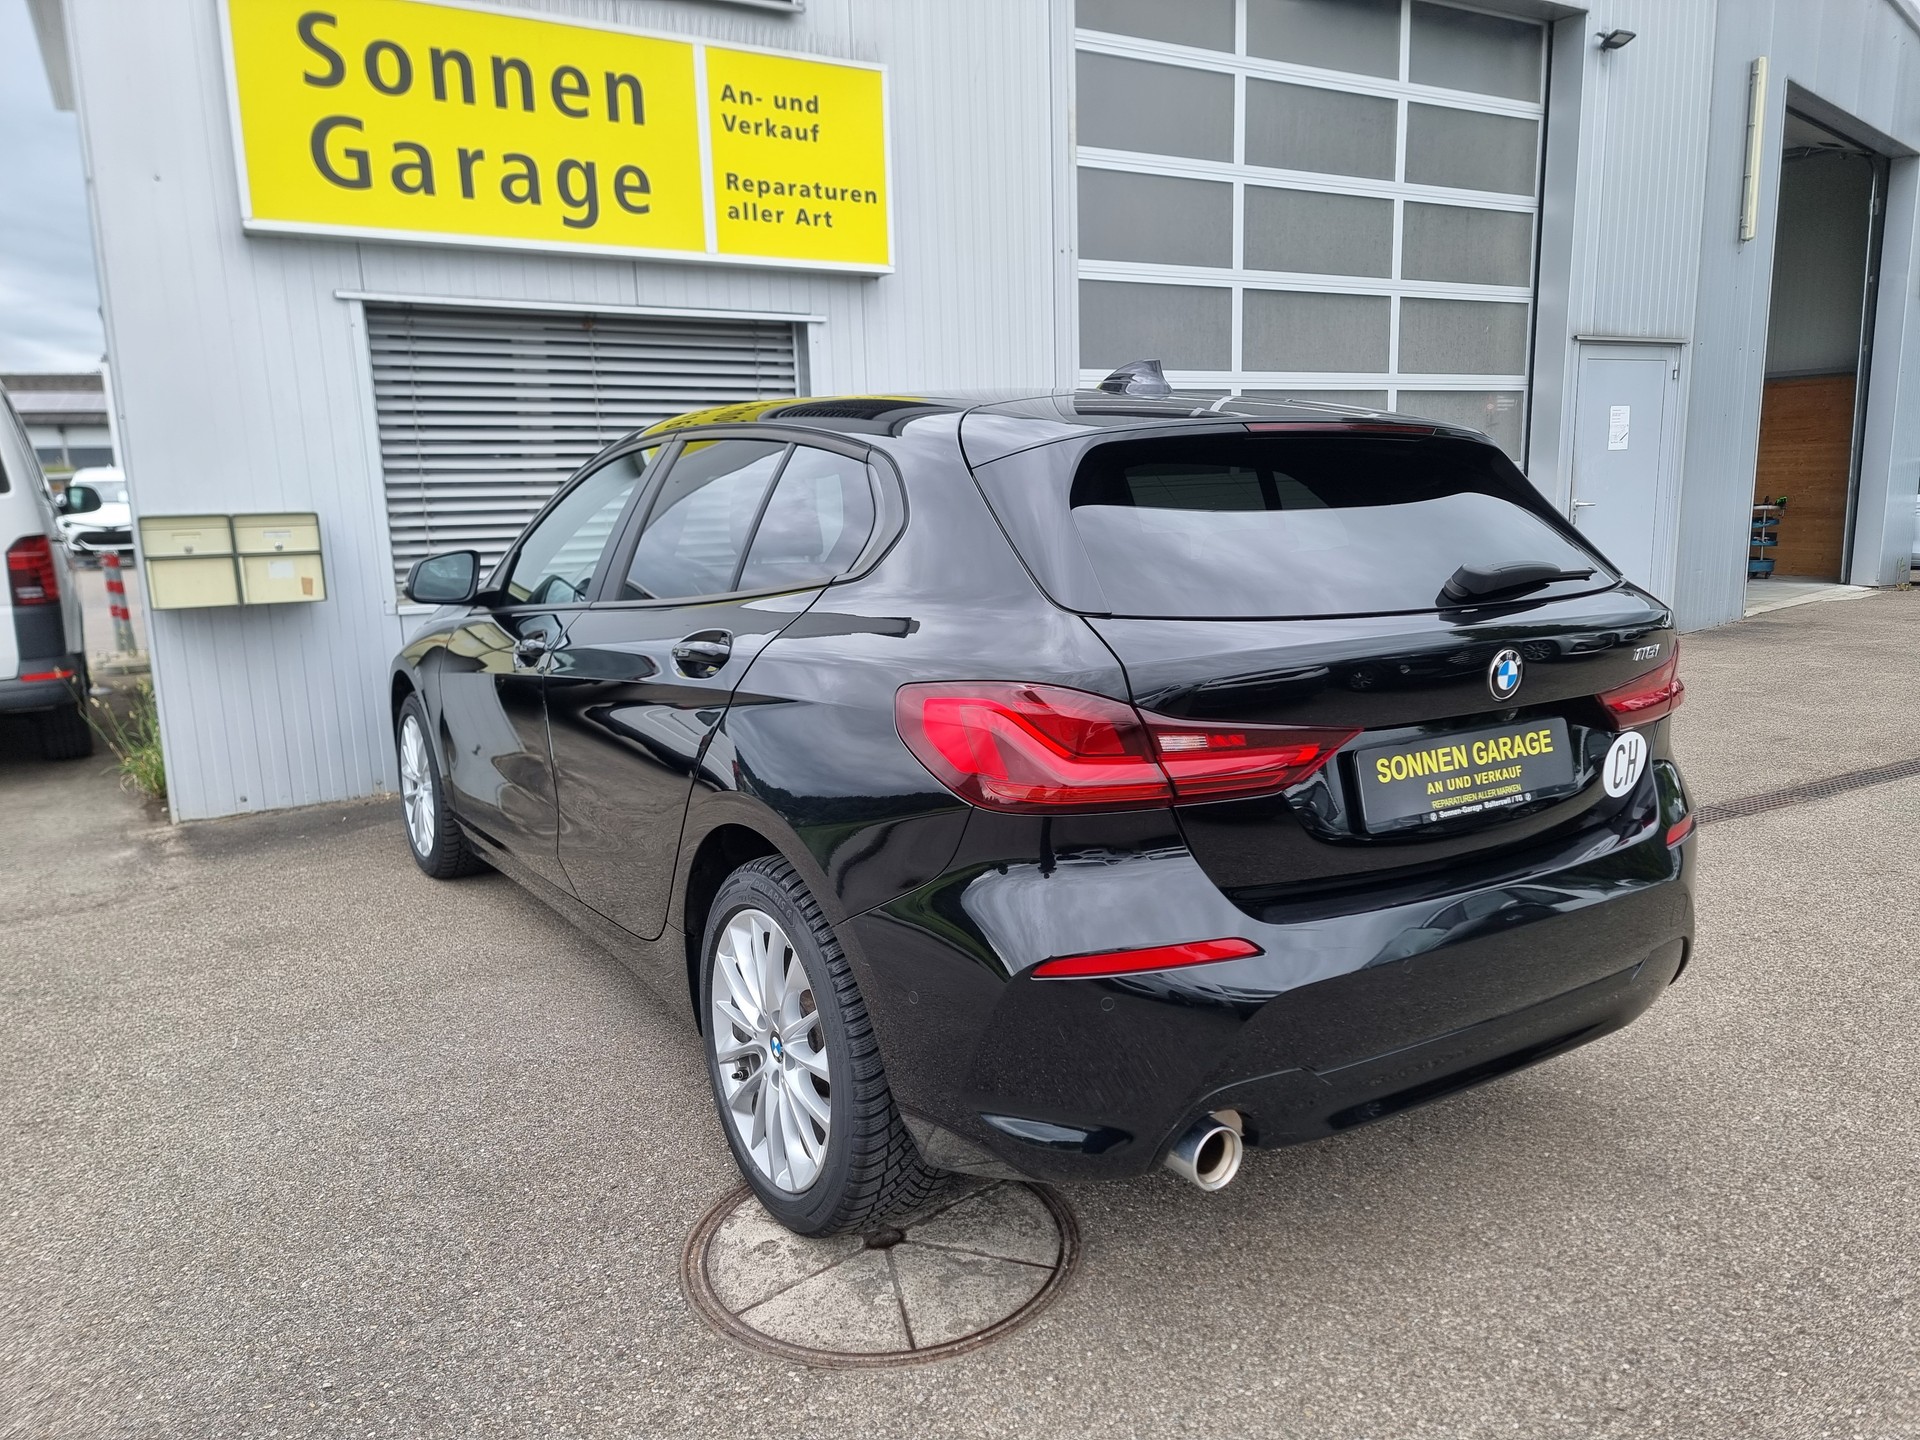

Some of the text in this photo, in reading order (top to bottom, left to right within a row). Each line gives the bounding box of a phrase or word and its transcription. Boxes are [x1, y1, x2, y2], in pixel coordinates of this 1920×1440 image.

[297, 11, 646, 126] Sonnen
[720, 84, 819, 114] An- und
[722, 113, 820, 143] Verkauf
[310, 115, 652, 230] Garage
[726, 172, 878, 204] Reparaturen
[728, 202, 833, 228] aller Art
[1375, 729, 1553, 784] SONNEN GARAGE
[1613, 738, 1638, 789] CH
[1427, 765, 1522, 795] AN UND VERKAUF
[1431, 783, 1522, 809] REPARATUREN ALLER MARKEN
[1439, 803, 1483, 818] Sonnen-Garage
[755, 880, 786, 910] POLARIS
[786, 909, 793, 919] 6
